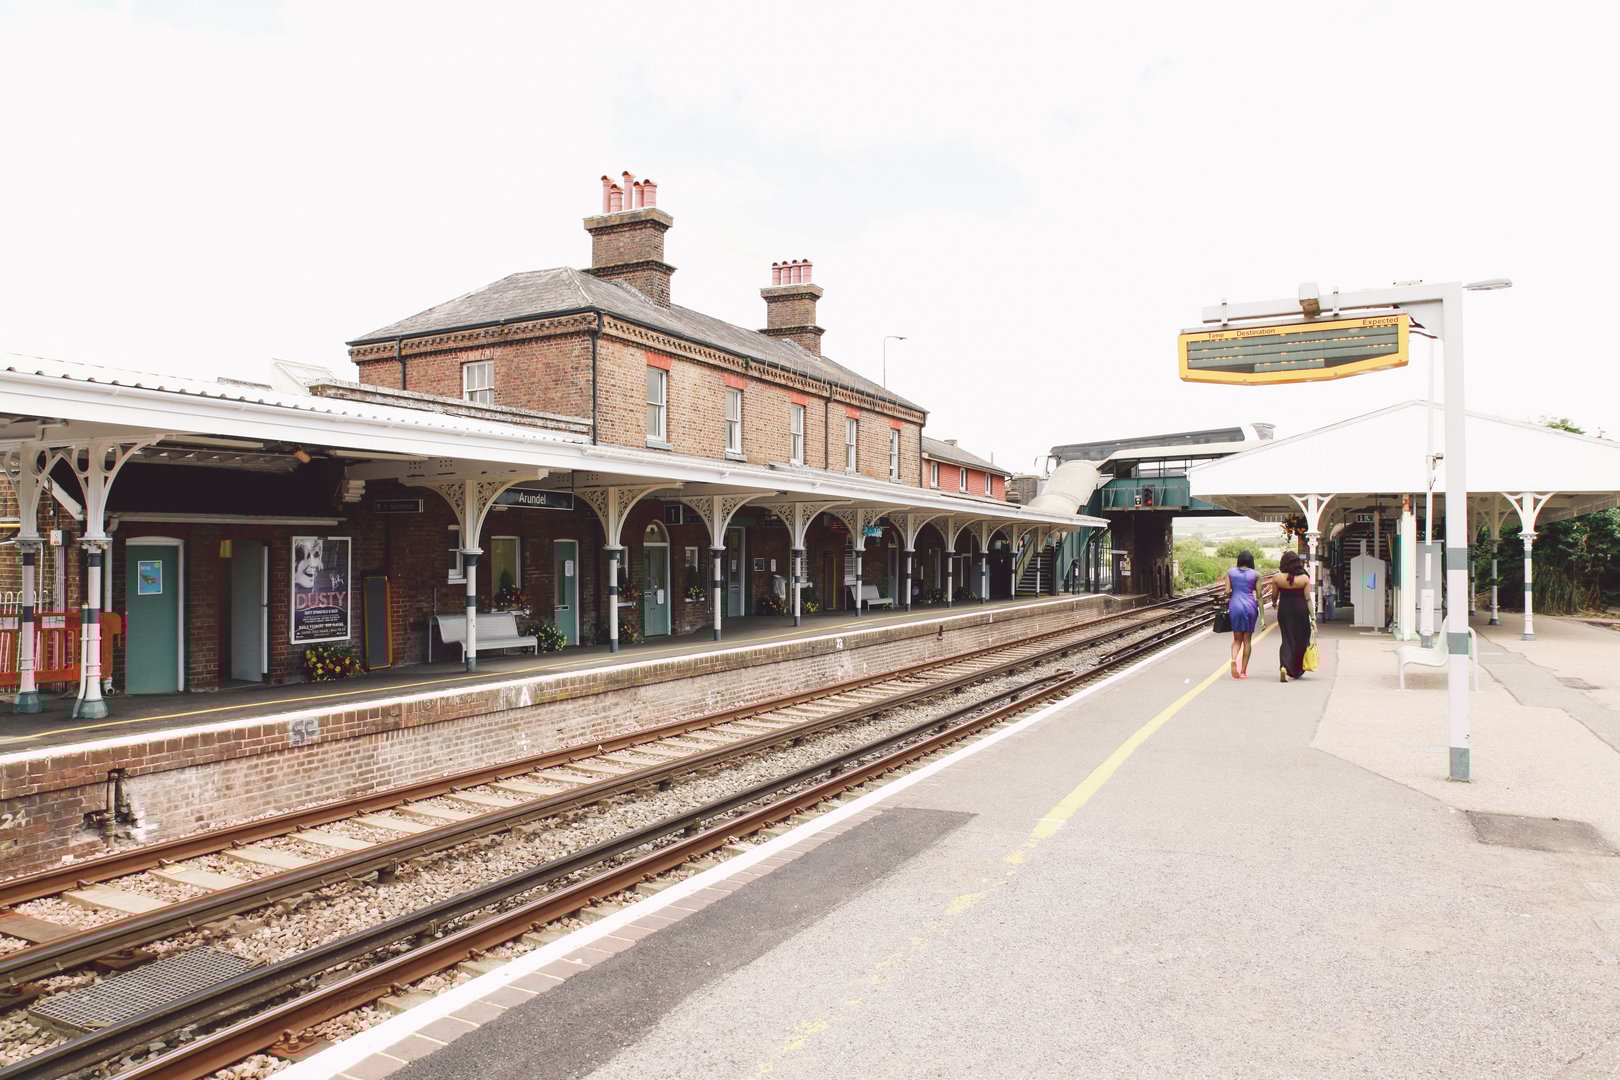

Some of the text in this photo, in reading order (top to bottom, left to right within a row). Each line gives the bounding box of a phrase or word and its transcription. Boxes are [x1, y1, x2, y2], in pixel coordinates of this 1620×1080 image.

[1362, 316, 1399, 326] Expected
[1236, 327, 1276, 337] Destination
[519, 492, 546, 505] Arundel
[296, 591, 346, 609] DUSTY
